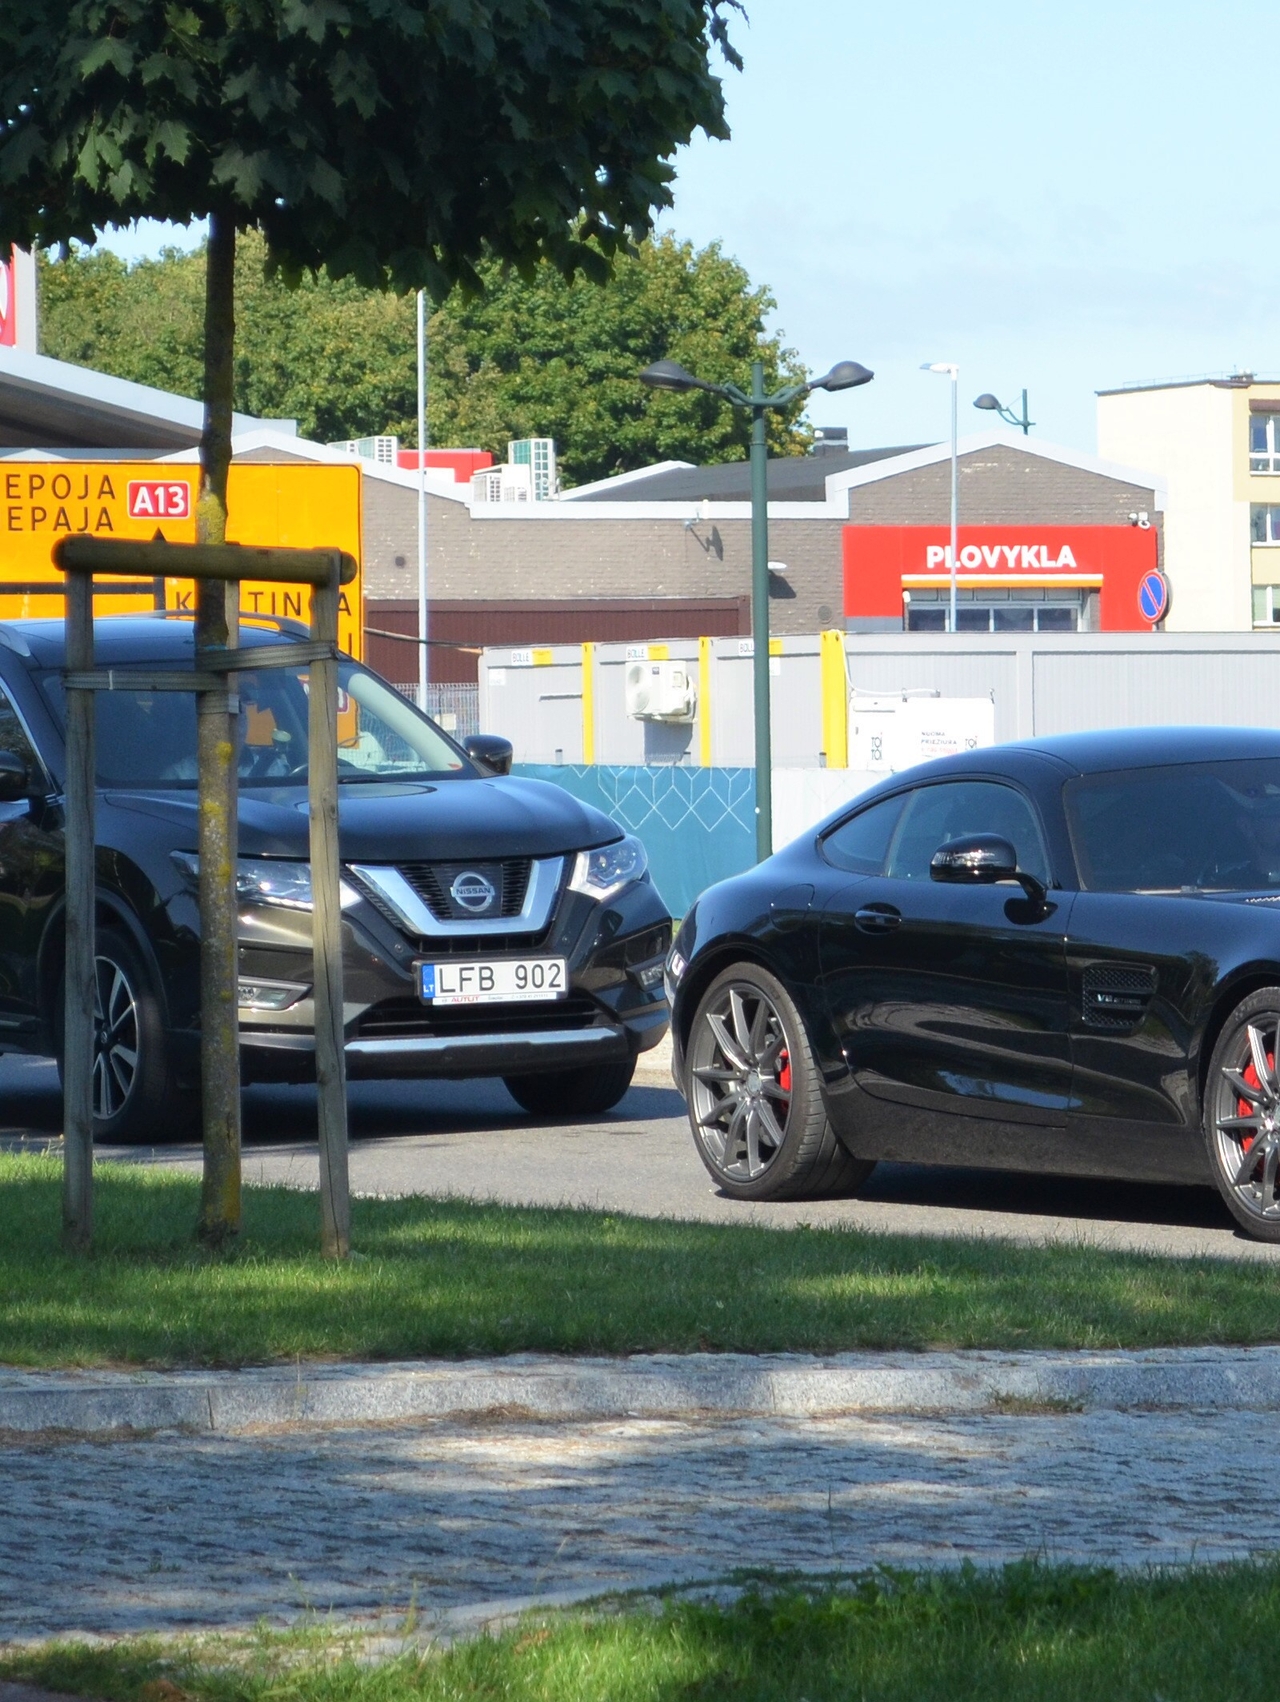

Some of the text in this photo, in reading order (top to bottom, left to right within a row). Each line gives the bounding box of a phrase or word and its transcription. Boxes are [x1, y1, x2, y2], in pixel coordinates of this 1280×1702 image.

[133, 486, 185, 515] A13
[926, 545, 1077, 568] PLOVYKLA
[176, 590, 352, 617] KTINA
[456, 887, 491, 895] NISSAN
[423, 963, 562, 993] LT LFB 902
